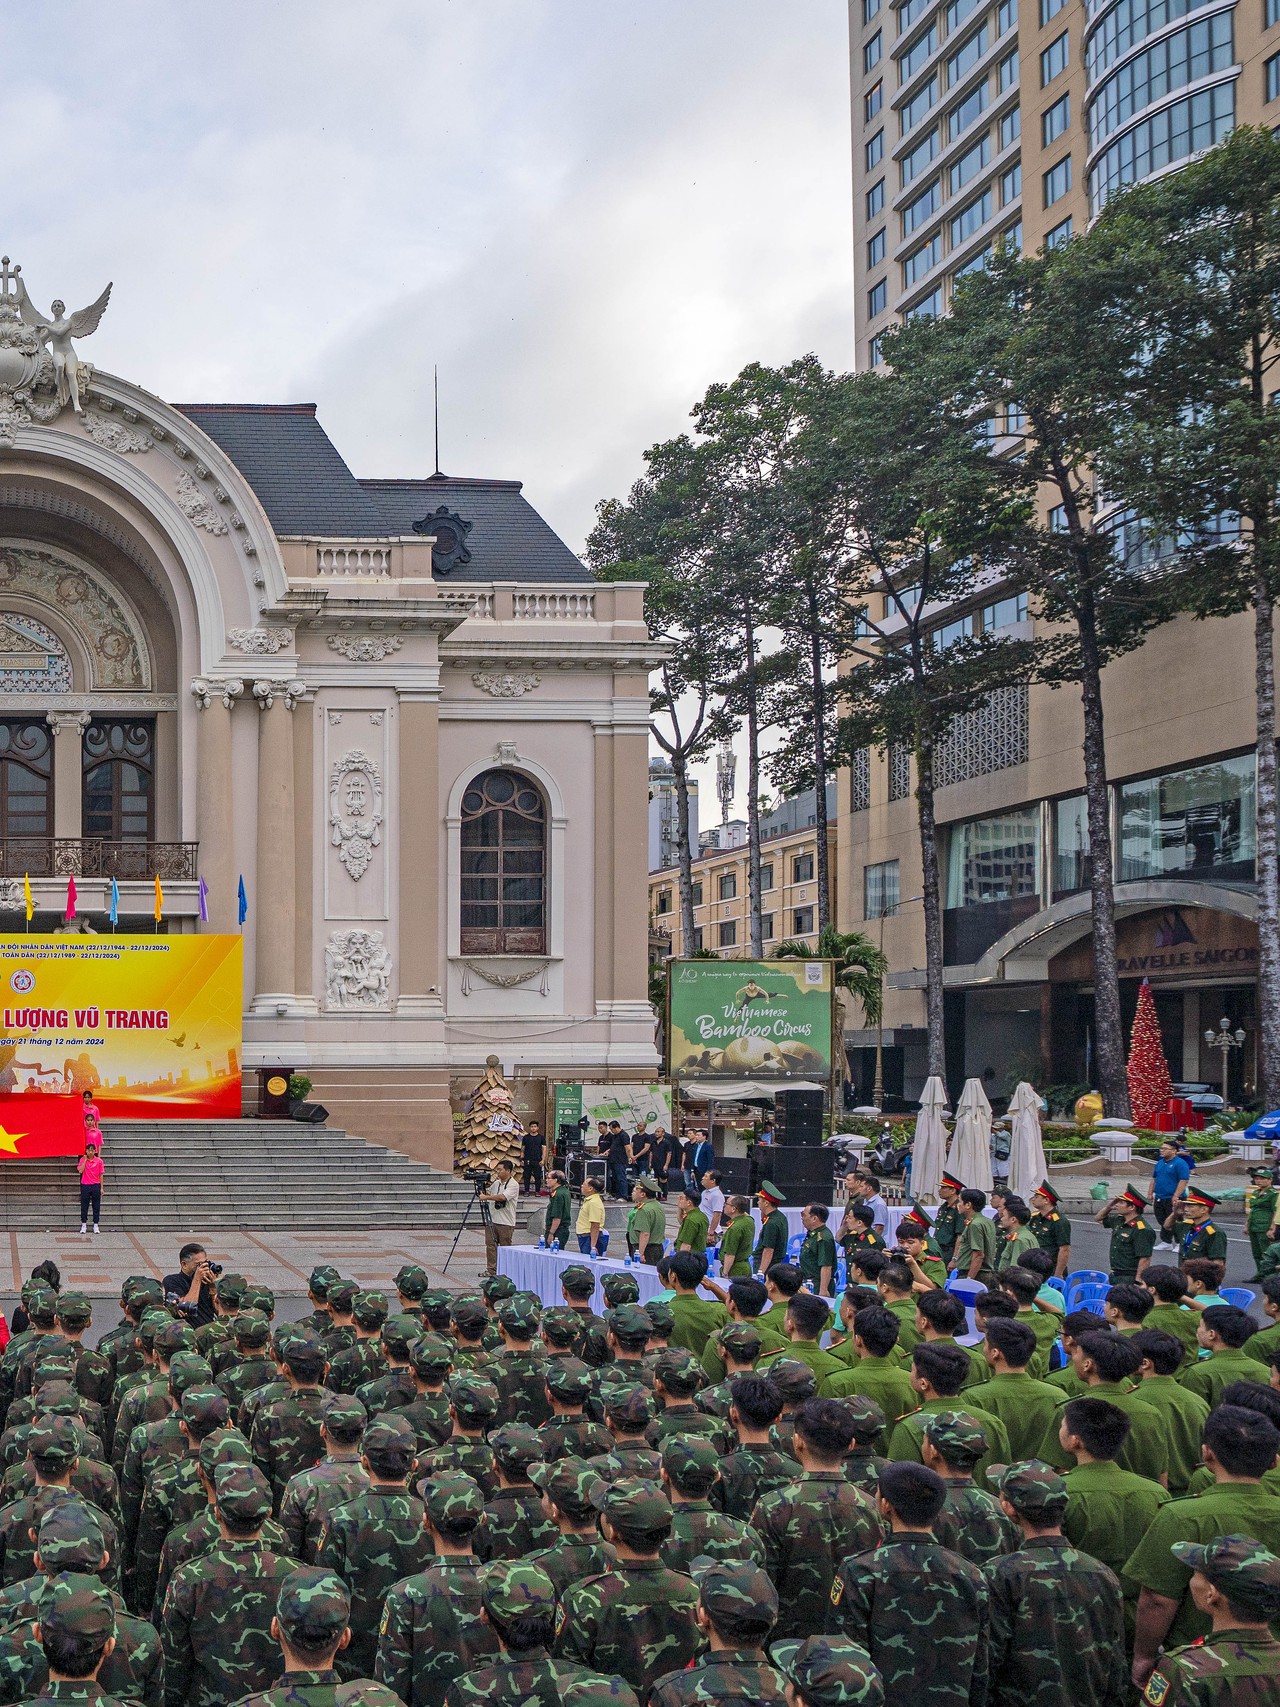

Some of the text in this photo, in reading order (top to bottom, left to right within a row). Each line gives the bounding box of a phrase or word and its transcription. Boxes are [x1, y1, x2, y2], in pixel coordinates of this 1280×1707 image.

[1118, 953, 1190, 970] RAVELLE
[5, 1008, 68, 1032] LƯỢNG
[74, 1007, 99, 1028] VŨ
[105, 1010, 168, 1028] TRANG
[721, 1002, 788, 1021] Vietnamese
[695, 1015, 812, 1039] Bamboo Circus
